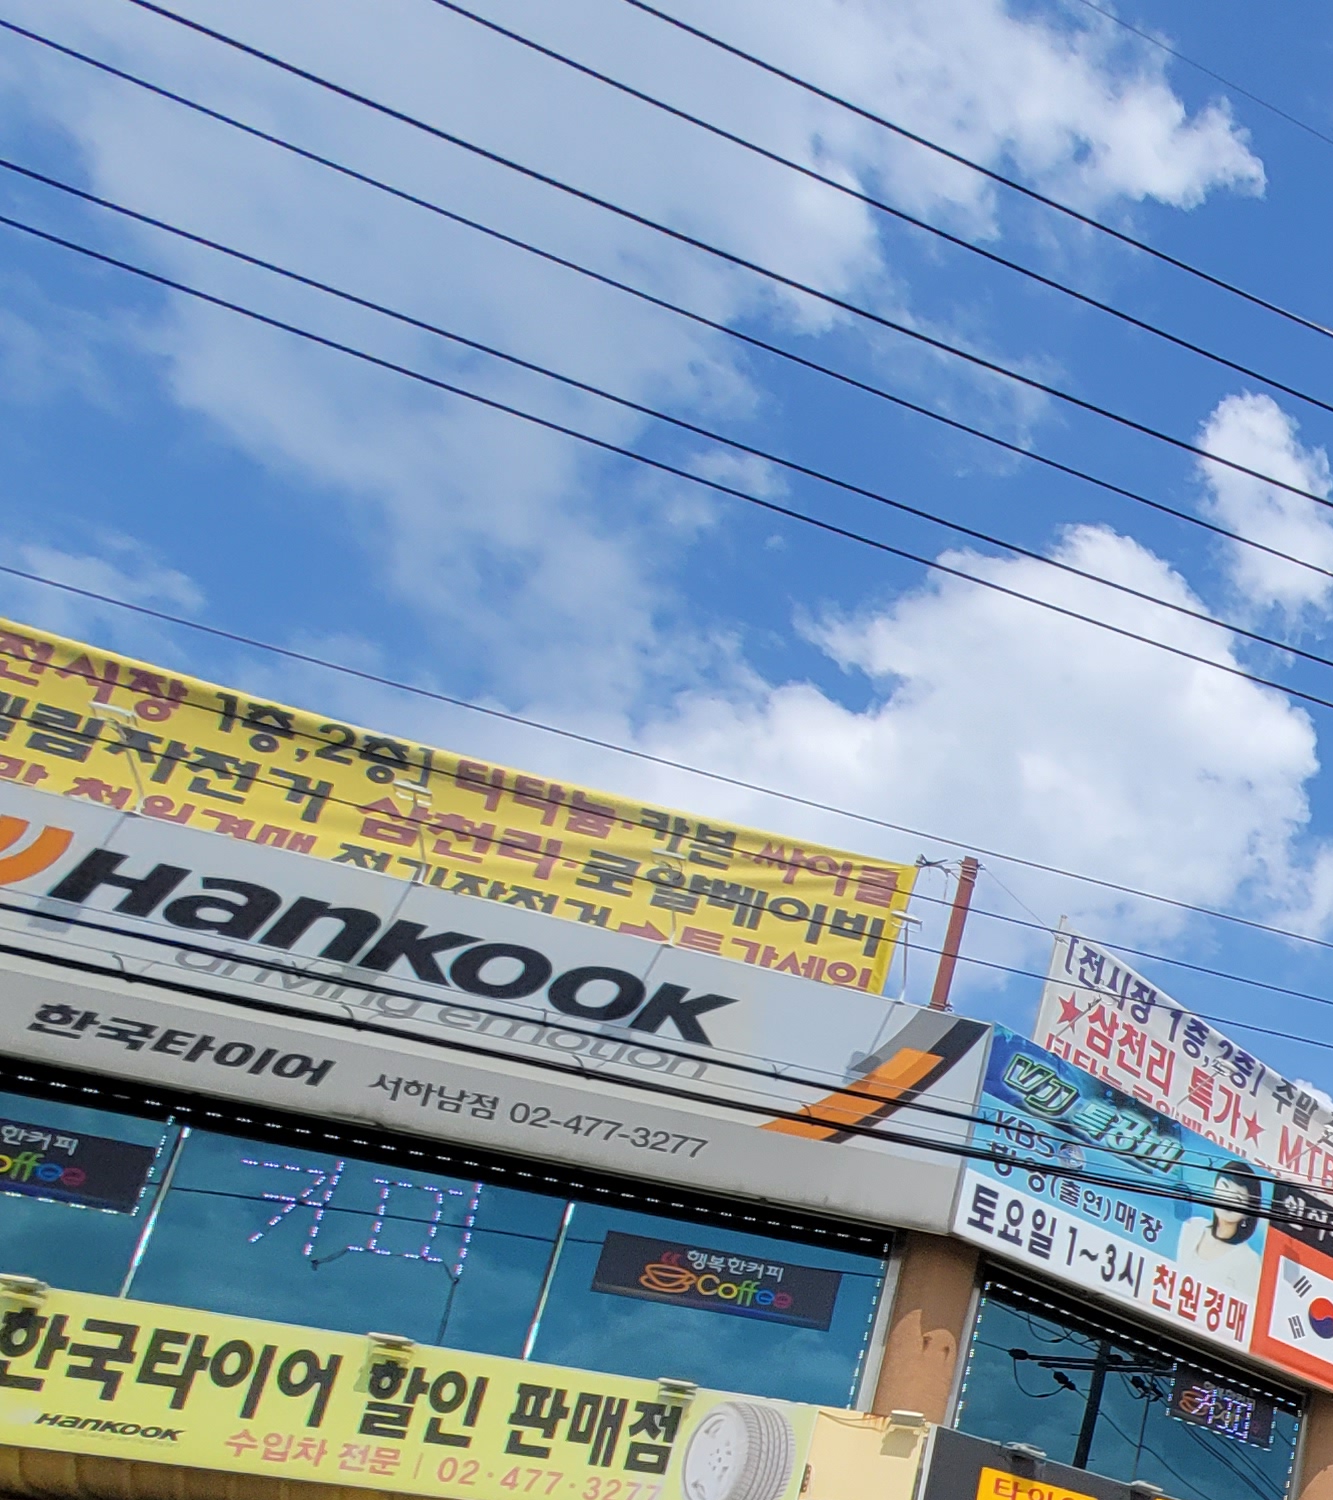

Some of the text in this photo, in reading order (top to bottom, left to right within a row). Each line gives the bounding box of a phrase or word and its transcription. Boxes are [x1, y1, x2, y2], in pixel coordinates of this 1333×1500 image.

[27, 1001, 708, 1159] 한국타이어 서하남점 02-477-3277
[1272, 1077, 1318, 1131] 주말
[993, 1111, 1054, 1158] KBS
[687, 1249, 784, 1283] 행복한커피
[967, 1184, 1057, 1259] 토요일
[1152, 1264, 1248, 1340] 천원경매
[696, 1274, 792, 1309] Coffee
[0, 1305, 682, 1477] 한국타이어 할인 판매점
[224, 1426, 328, 1470] 수입차
[338, 1440, 401, 1479] 전문
